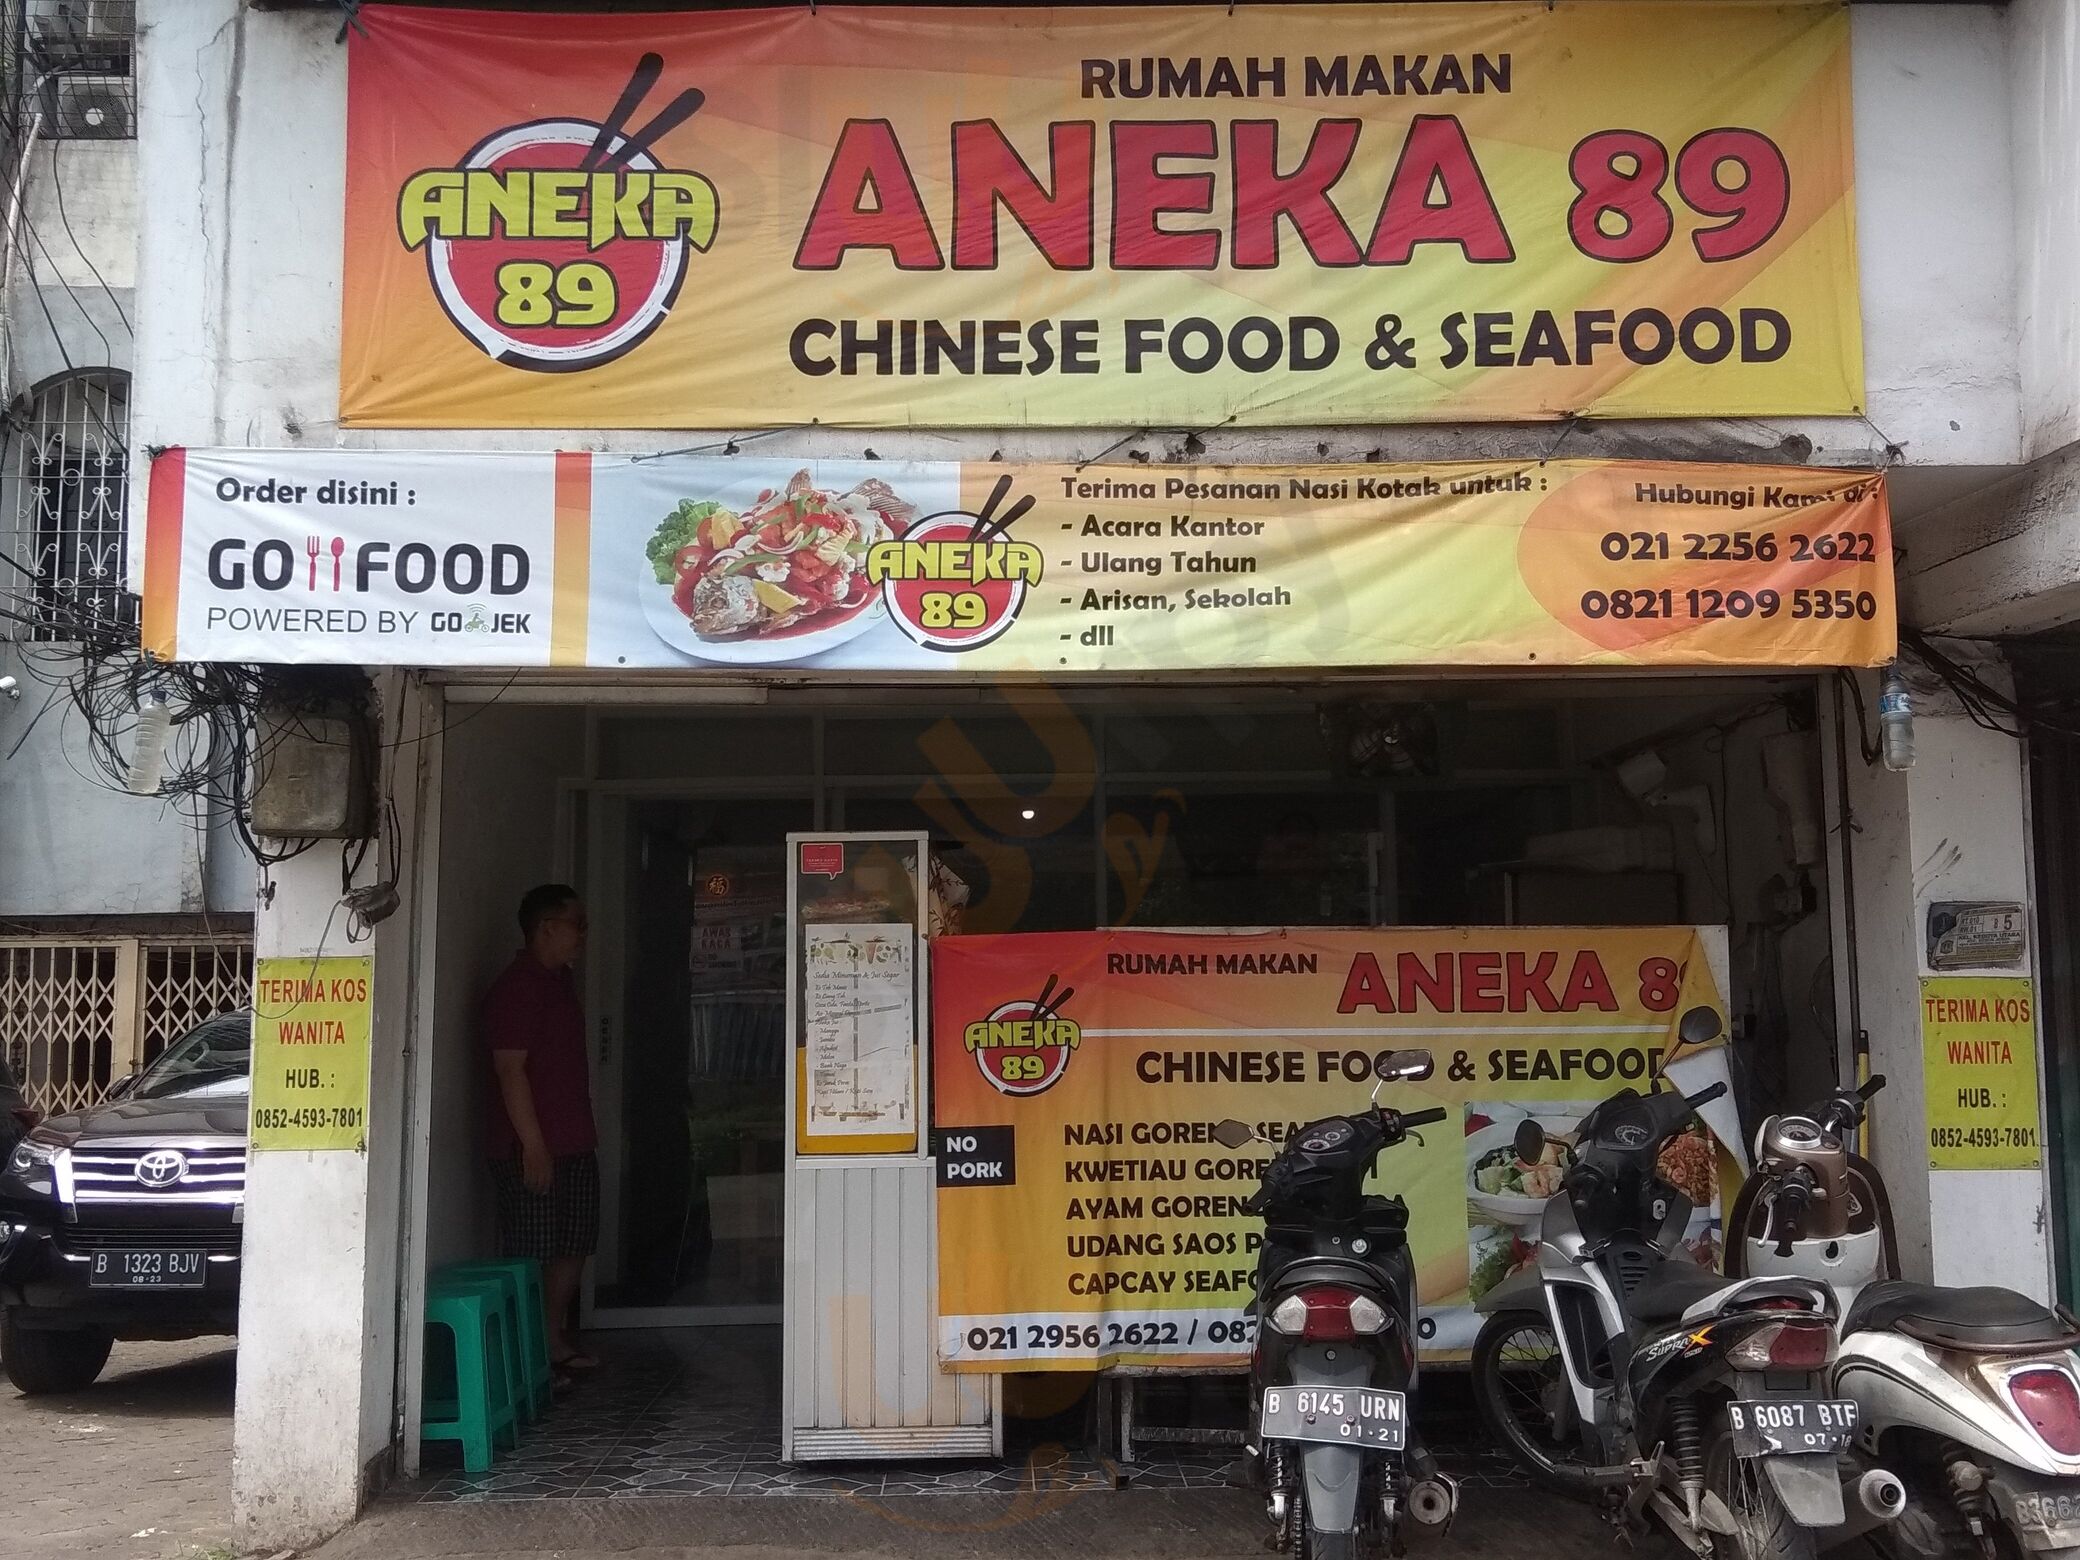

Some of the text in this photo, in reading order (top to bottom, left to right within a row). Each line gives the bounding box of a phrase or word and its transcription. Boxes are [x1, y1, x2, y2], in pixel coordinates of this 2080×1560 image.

[1081, 53, 1511, 98] RUMAH MAKAN
[792, 115, 1791, 271] ANEKA 89
[397, 168, 720, 253] ANEKA
[495, 260, 618, 328] 89
[789, 307, 1792, 377] CHINESE FOOD & SEAFOOD
[215, 477, 308, 504] Order
[316, 478, 398, 505] disini
[1061, 477, 1156, 499] Terima
[1166, 478, 1280, 499] Pesanan
[1290, 479, 1359, 499] Nasi
[1366, 475, 1440, 499] Kotak
[1450, 473, 1533, 496] untuk
[1634, 482, 1755, 510] Hubungi
[1081, 516, 1162, 537] Acara
[1171, 516, 1265, 537] Kantor
[1600, 531, 1876, 563] 021 2256 2622
[208, 539, 530, 595] GO FOOD
[866, 540, 1045, 588] ANEKA
[1081, 552, 1162, 577] Ulang
[1170, 552, 1257, 573] Tahun
[919, 591, 989, 629] 89
[1080, 588, 1176, 613] Arisan,
[1185, 586, 1291, 610] Sekolah
[1581, 589, 1877, 621] 0821 1209 5350
[208, 607, 418, 634] POWERED BY
[431, 612, 531, 634] GO JEK
[1080, 625, 1114, 647] dll
[2004, 915, 2012, 930] 5
[1107, 953, 1318, 975] RUMAH MAKAN
[260, 979, 366, 1003] TERIMA KOS
[1337, 950, 1688, 1014] ANEKA 8
[1926, 999, 2030, 1023] TERIMA KOS
[279, 1021, 345, 1044] WANITA
[963, 1019, 1082, 1054] ANEKA
[1947, 1041, 2012, 1065] WANITA
[286, 1069, 324, 1088] HUB.
[1000, 1055, 1046, 1081] 89
[1136, 1051, 1306, 1083] CHINESE
[1448, 1049, 1475, 1082] &
[1958, 1088, 1997, 1108] HUB.
[255, 1107, 363, 1128] 0852-4593-7801
[946, 1136, 977, 1153] NO
[1065, 1122, 1123, 1146] NASI
[1931, 1128, 2036, 1148] 0852-4593-7801
[947, 1161, 1002, 1179] PORK
[1065, 1159, 1186, 1183] KWETIAU
[1066, 1196, 1250, 1221] AYAM GOREN
[1067, 1233, 1165, 1257] UDANG
[1172, 1232, 1237, 1256] SAOS
[95, 1254, 199, 1273] B 1323 BJV
[1068, 1271, 1176, 1295] CAPCAY
[967, 1326, 1018, 1351] 021
[1027, 1324, 1100, 1349] 2956
[1108, 1322, 1179, 1346] 2622
[1269, 1393, 1400, 1422] B 6145 URN
[1731, 1406, 1744, 1430] B
[1755, 1404, 1805, 1428] 6087
